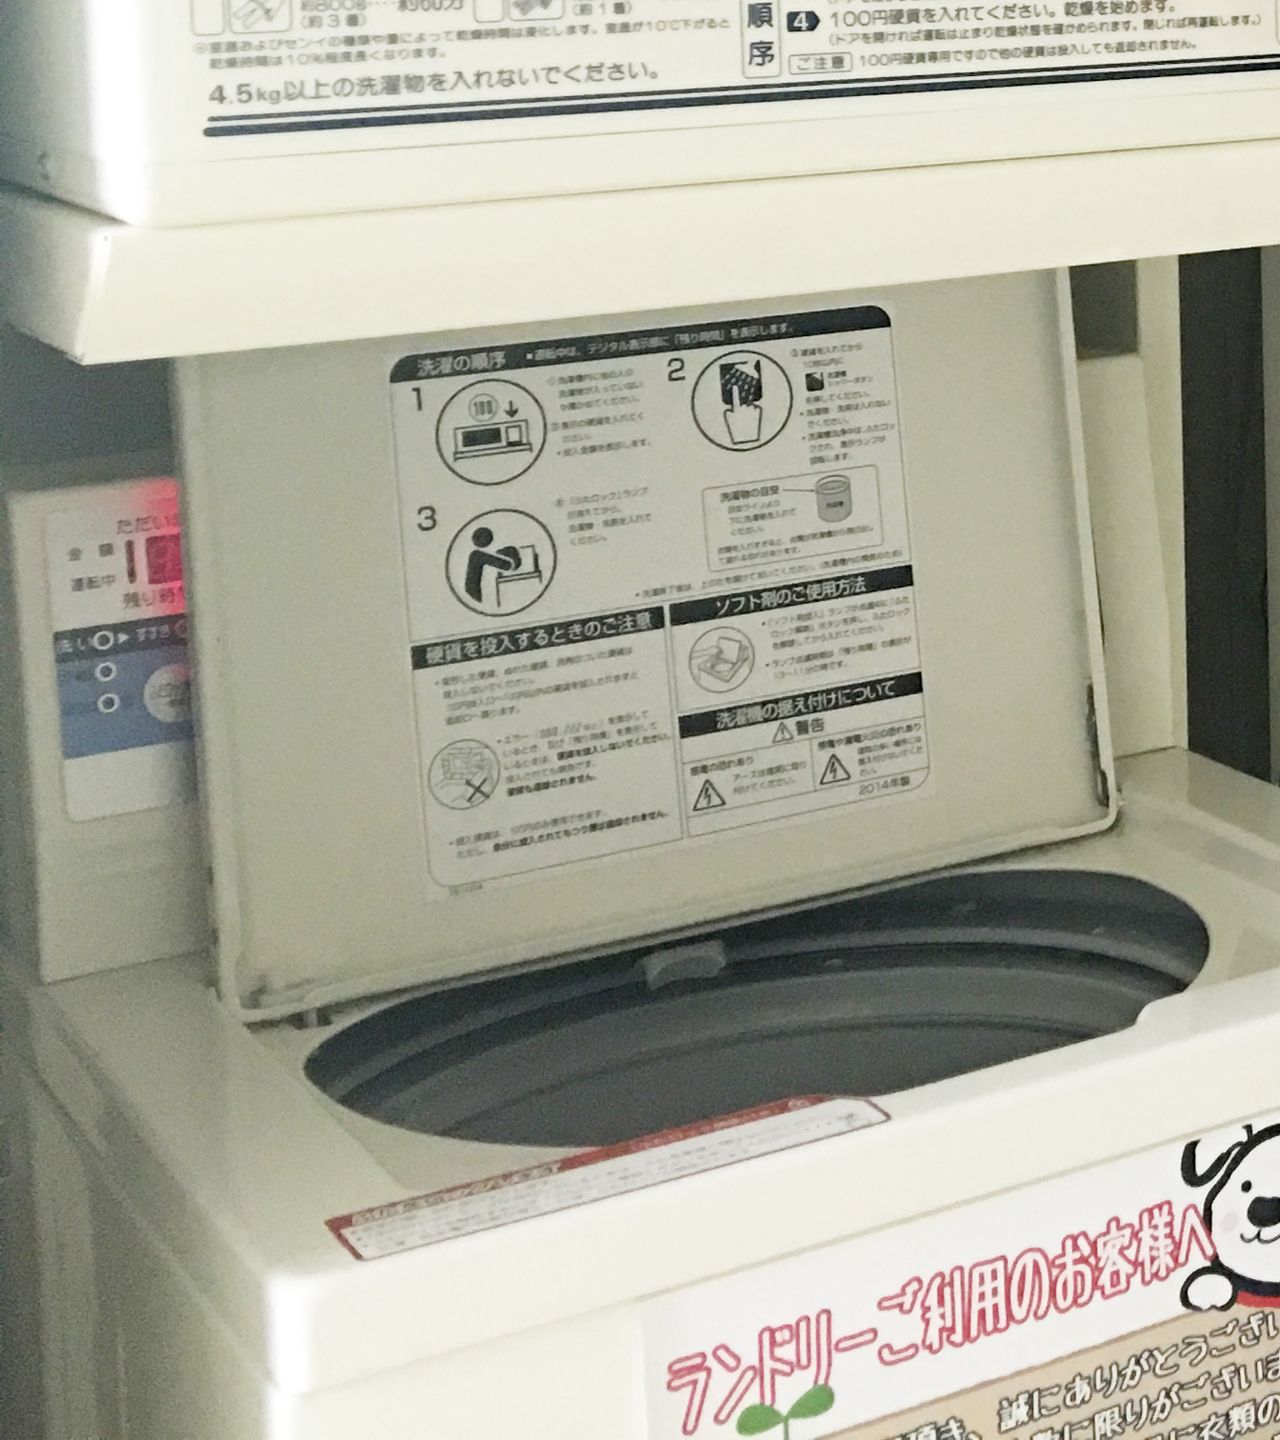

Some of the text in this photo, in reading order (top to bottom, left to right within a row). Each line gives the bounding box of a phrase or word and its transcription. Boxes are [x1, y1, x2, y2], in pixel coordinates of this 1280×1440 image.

[792, 13, 809, 30] 4
[207, 61, 659, 105] 4.5kg以上の洗濯物を入れないでください。
[416, 351, 507, 378] 洗濯の順序
[667, 357, 686, 382] 2
[411, 387, 423, 412] 1
[417, 506, 438, 531] 3
[715, 576, 867, 616] ソフト剤のご使用方法
[425, 611, 652, 664] 硬貨を投入するときのご注意
[668, 1200, 1216, 1436] ランドリーご利用のお客様へ
